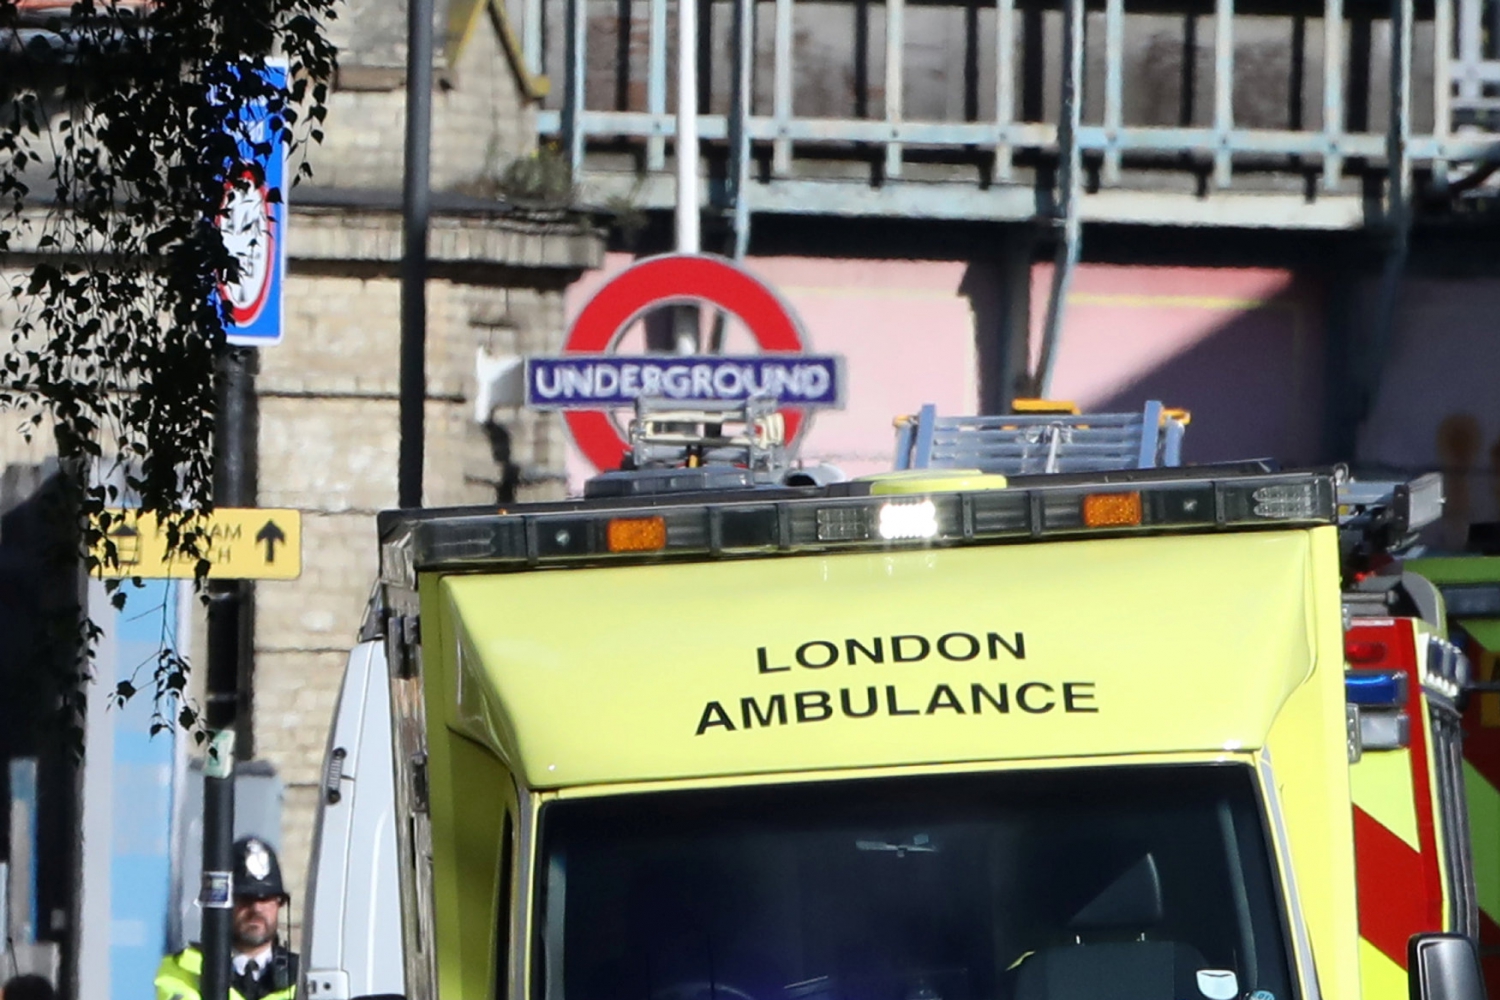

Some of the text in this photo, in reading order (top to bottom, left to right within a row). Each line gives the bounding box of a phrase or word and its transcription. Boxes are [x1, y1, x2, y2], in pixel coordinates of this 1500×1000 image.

[535, 363, 831, 399] UNDERGROUND
[756, 631, 1026, 675] LONDON
[694, 681, 1099, 736] AMBULANCE
